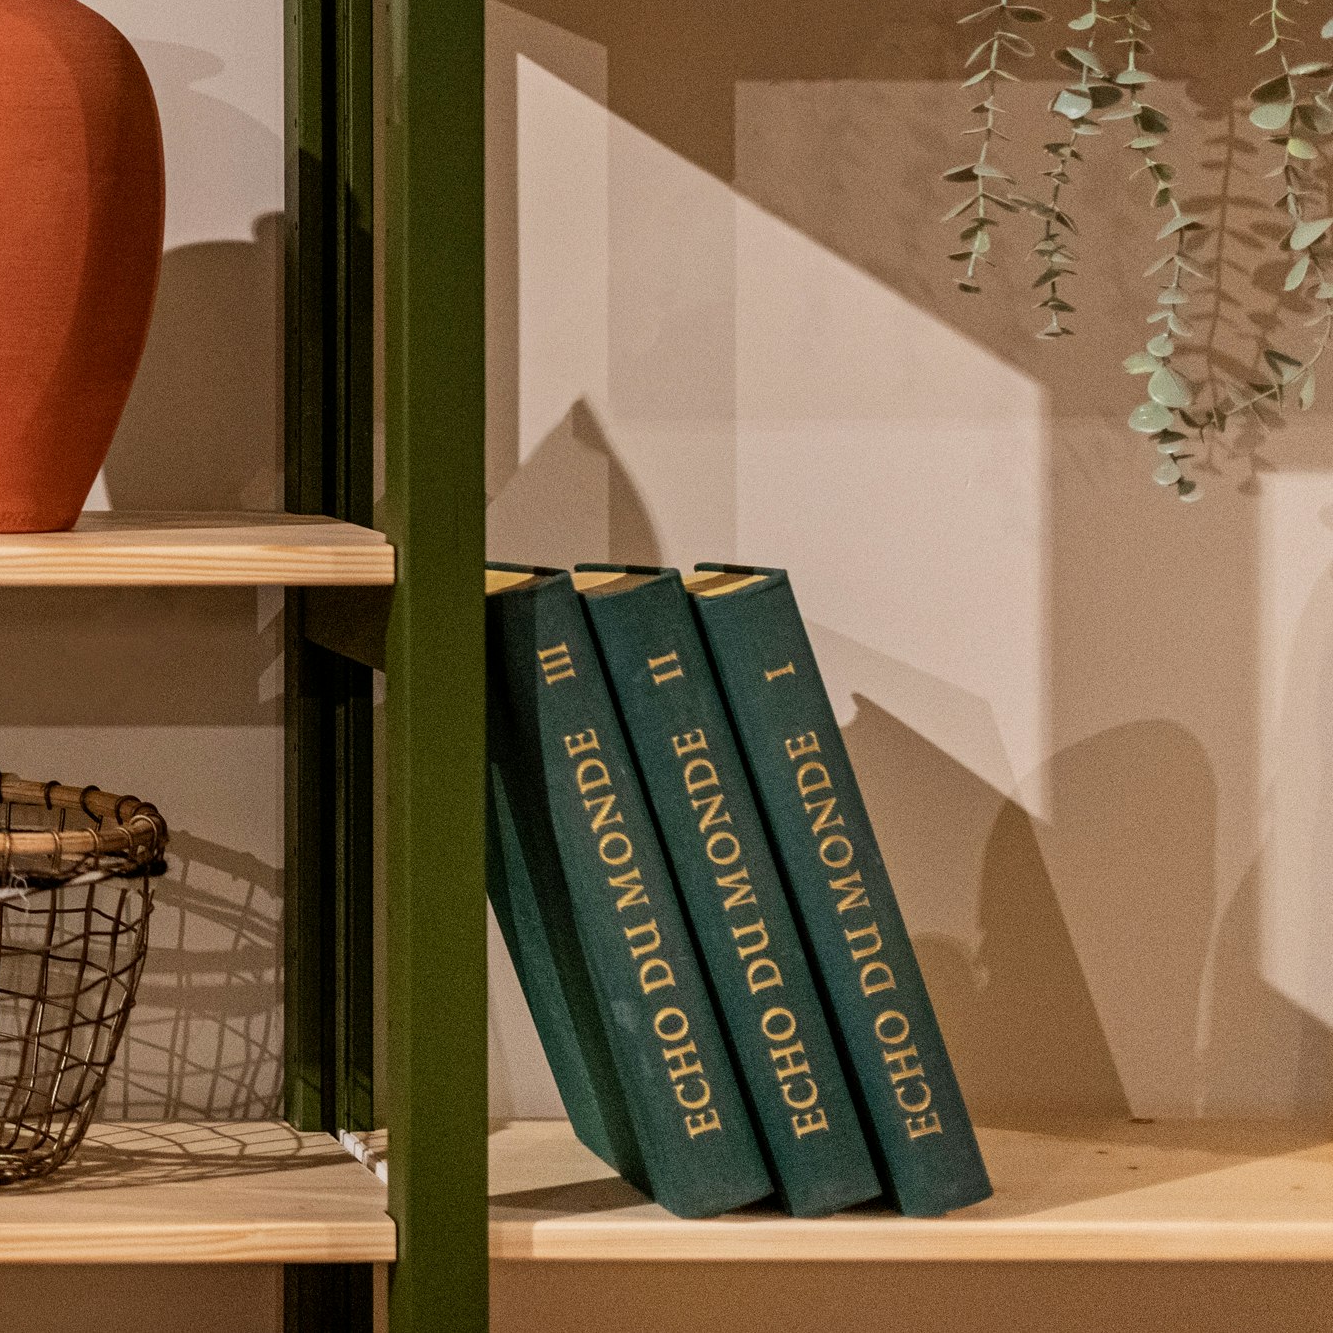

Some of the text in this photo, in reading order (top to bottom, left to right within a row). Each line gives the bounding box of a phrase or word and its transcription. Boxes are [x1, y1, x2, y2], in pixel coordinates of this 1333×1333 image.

[537, 642, 722, 1138] ECHO DU MONDE III
[647, 651, 829, 1138] ECHO DU MONDE II
[765, 662, 942, 1139] ECHO DU MONDE I
